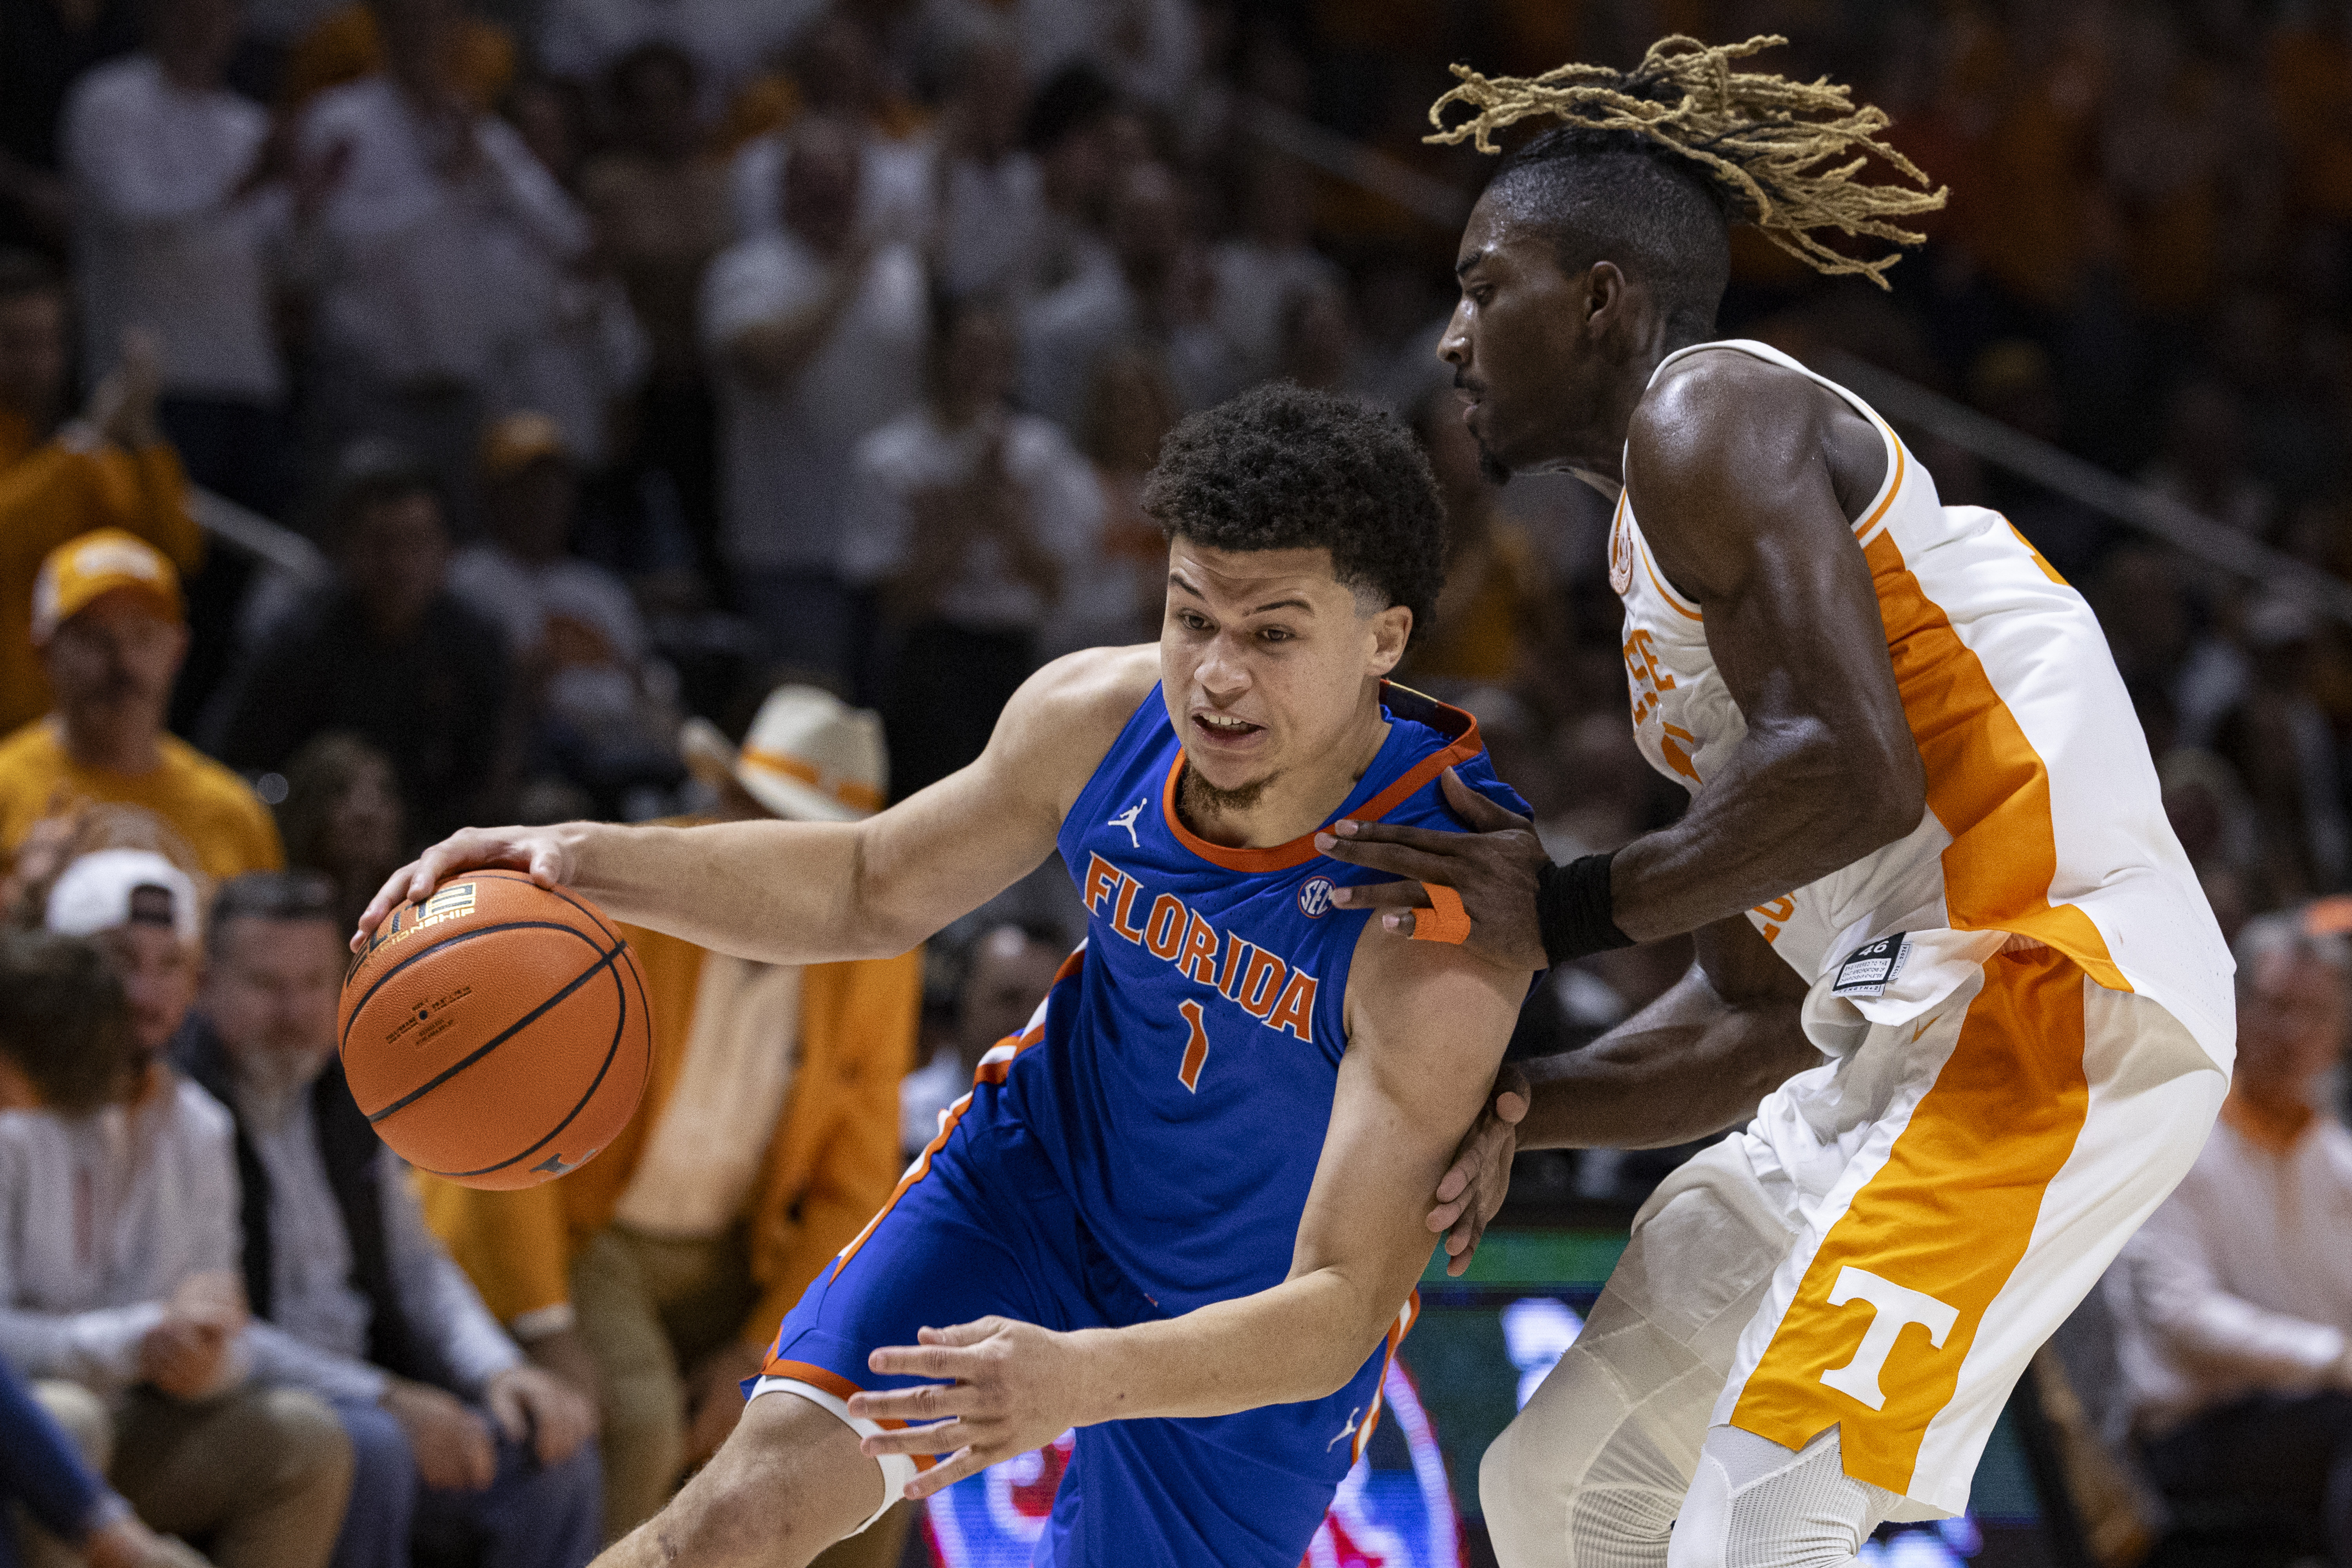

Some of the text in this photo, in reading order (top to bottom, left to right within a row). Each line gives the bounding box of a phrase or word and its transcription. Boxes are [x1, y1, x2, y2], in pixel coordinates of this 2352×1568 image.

[1301, 880, 1334, 915] SEC
[1083, 850, 1319, 1043] FLORIDA
[1858, 941, 1889, 956] 46
[1178, 998, 1209, 1094] 1
[1818, 1265, 1960, 1412] T
